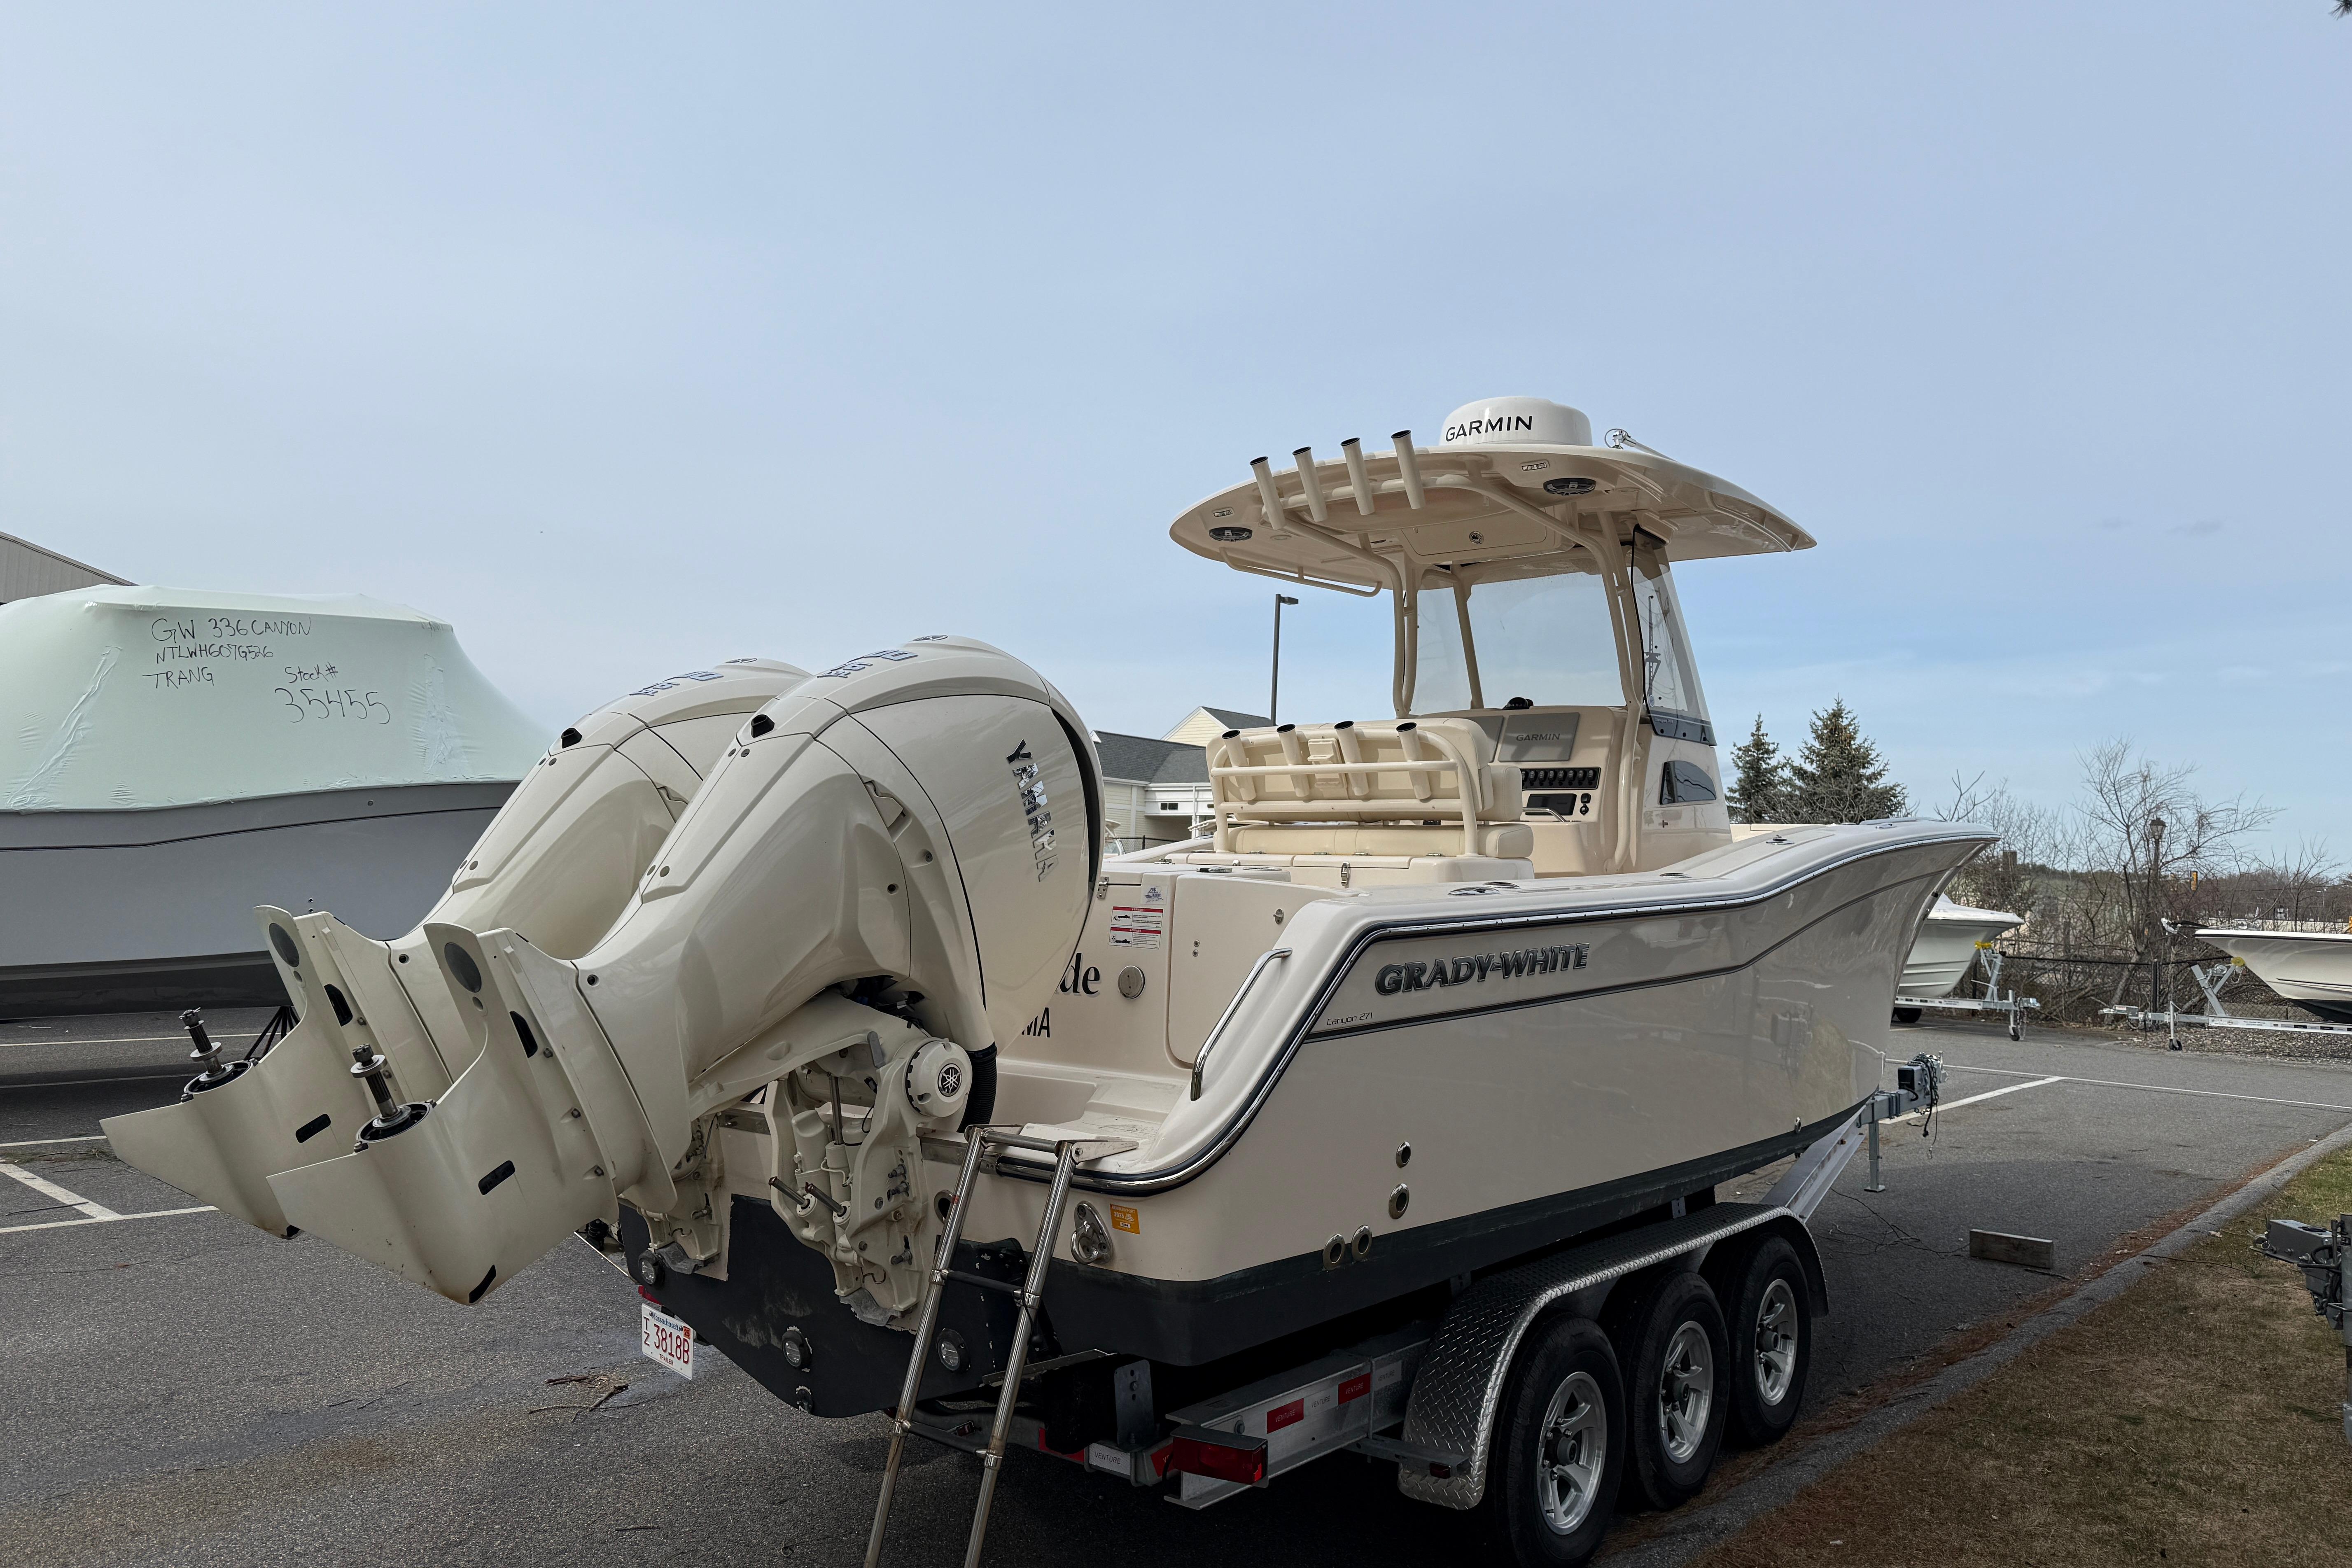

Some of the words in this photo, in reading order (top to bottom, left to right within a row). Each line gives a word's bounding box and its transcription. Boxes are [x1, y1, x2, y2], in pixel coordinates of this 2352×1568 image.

[1446, 415, 1532, 442] GARMIN
[151, 618, 195, 643] GW
[142, 666, 215, 689] TRANG
[275, 687, 390, 724] 35455
[1006, 738, 1059, 882] YAMAHA
[1375, 943, 1590, 996] GRADY-WHITE
[1327, 1016, 1357, 1025] Canyon
[1359, 1012, 1372, 1020] 271
[651, 1312, 682, 1331] Massachusetts
[653, 1323, 689, 1364] 3818B
[659, 1354, 674, 1366] TRAILER
[1378, 1370, 1395, 1381] VENTURE
[1345, 1382, 1364, 1395] VENTURE
[1311, 1395, 1331, 1408] VENTURE
[1274, 1409, 1296, 1423] VENTURE
[1095, 1451, 1121, 1465] VENTURE
